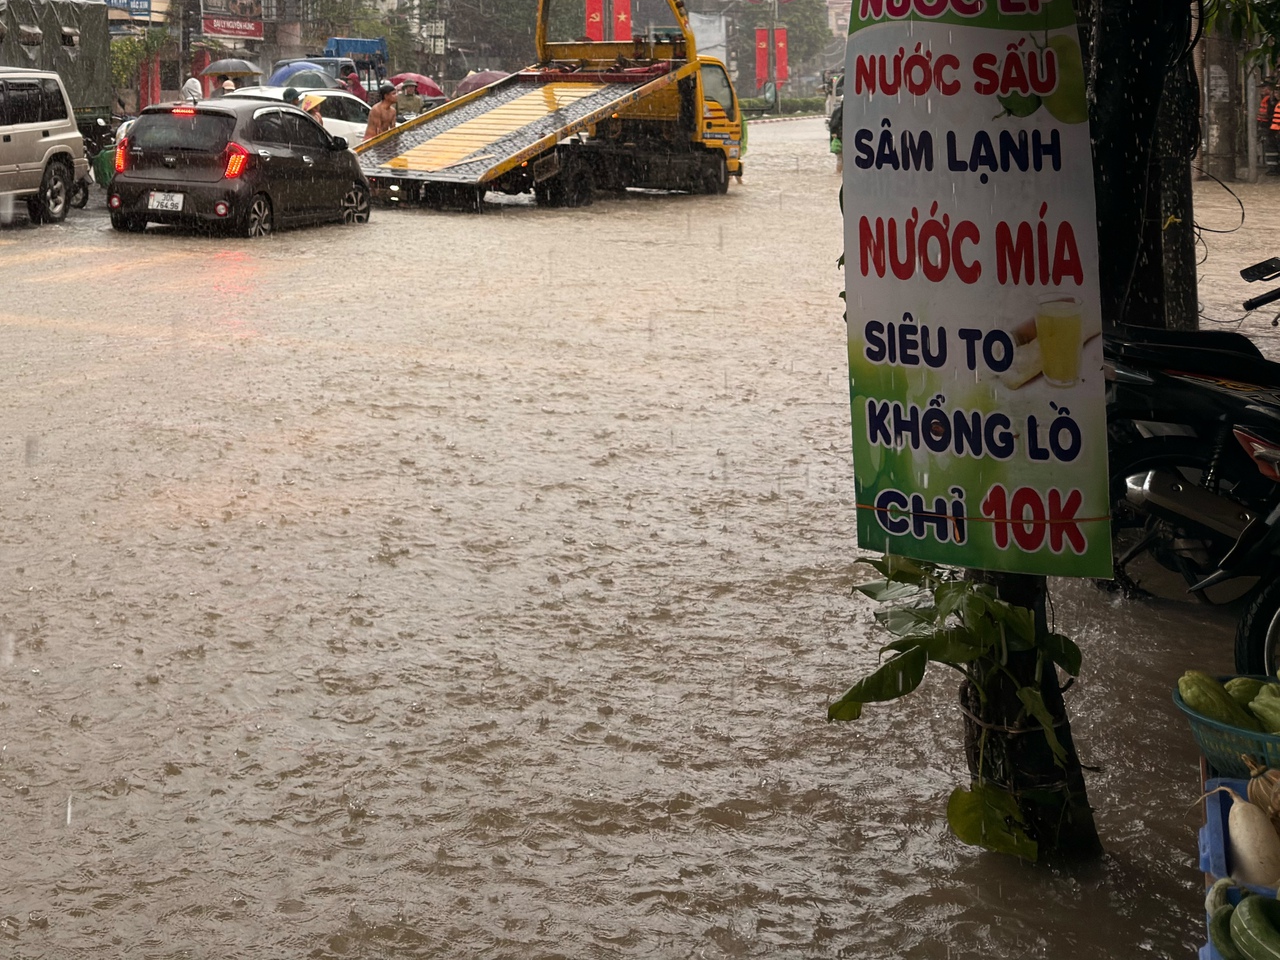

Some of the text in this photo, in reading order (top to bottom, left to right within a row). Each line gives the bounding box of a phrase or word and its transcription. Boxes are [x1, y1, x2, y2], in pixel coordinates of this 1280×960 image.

[855, 38, 1059, 96] NƯỚC SẤU
[855, 118, 1062, 184] SÂM LẠNH
[859, 201, 1084, 287] NƯỚC MÍA
[865, 312, 1014, 373] SIÊU TO
[867, 393, 1082, 462] KHỔNG LỒ
[875, 486, 1088, 555] CHỈ 10K
